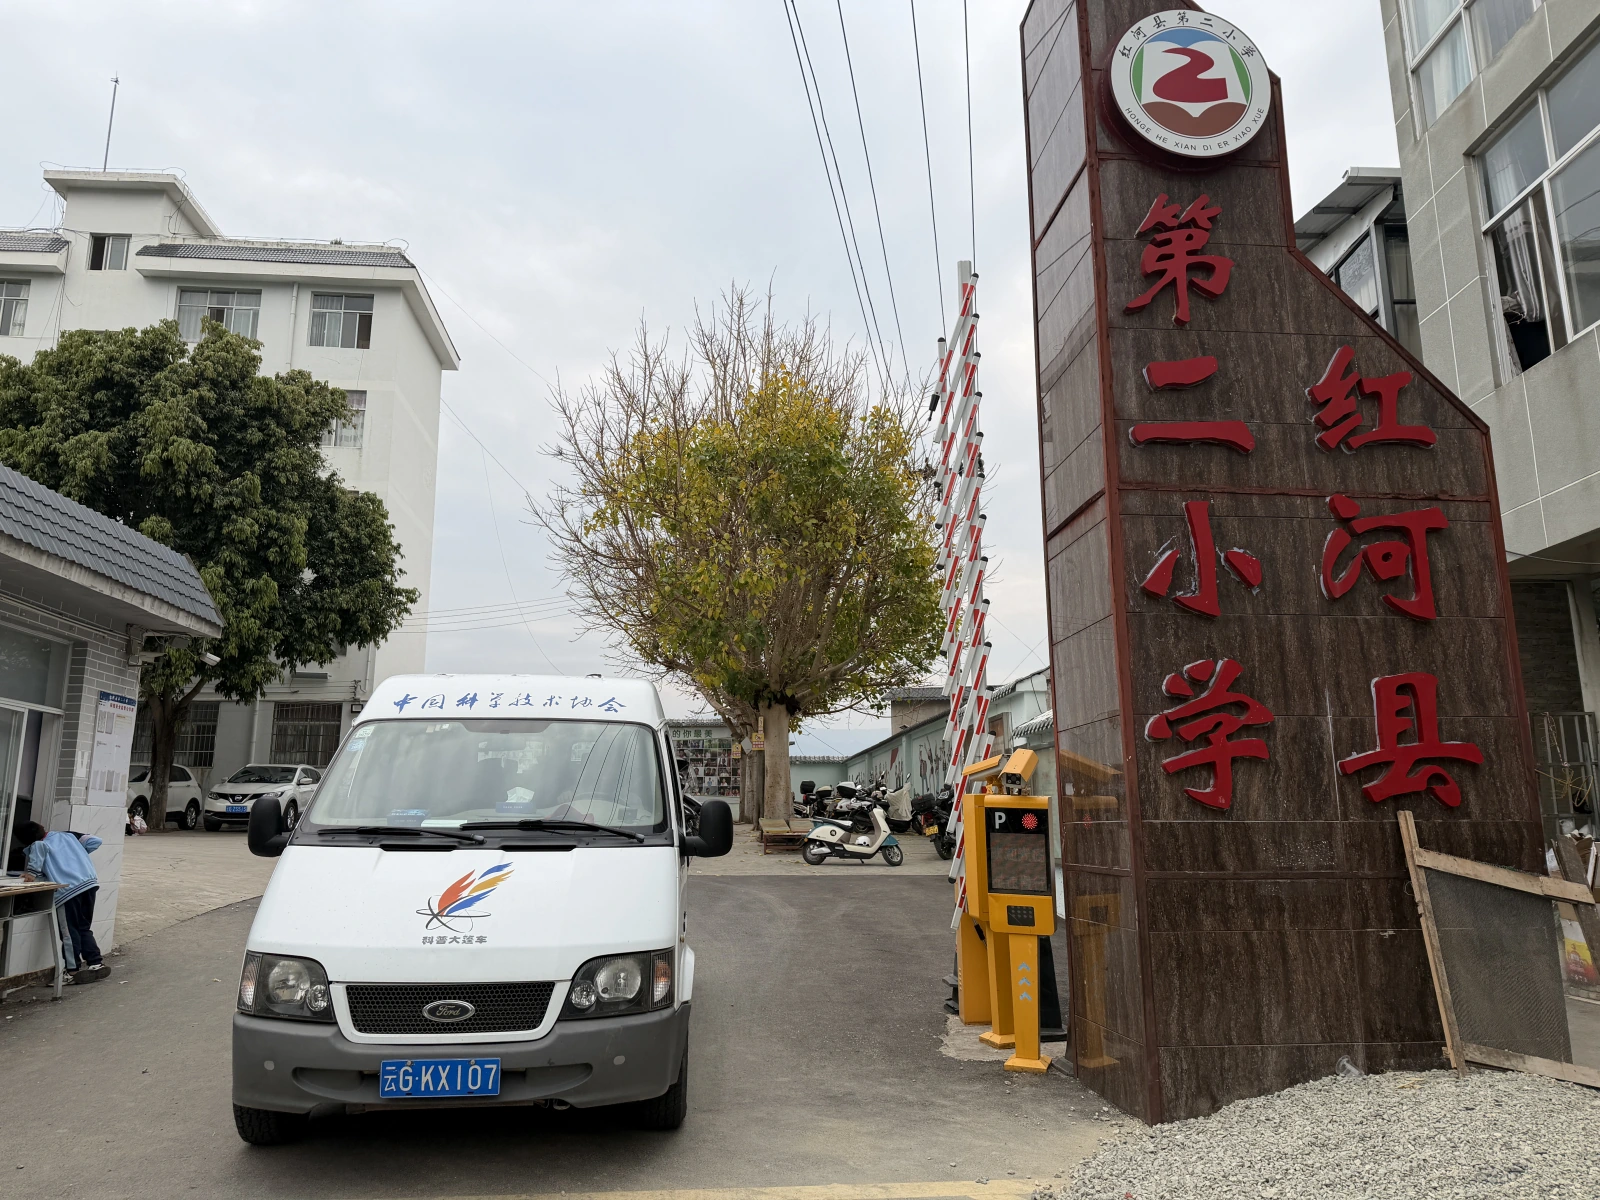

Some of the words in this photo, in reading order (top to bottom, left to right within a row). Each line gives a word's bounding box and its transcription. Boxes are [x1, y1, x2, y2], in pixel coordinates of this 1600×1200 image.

[1119, 11, 1257, 59] 红河县第二小学
[1125, 107, 1152, 134] HONGE
[1155, 134, 1168, 144] HE
[1174, 141, 1197, 151] XIAN
[1217, 140, 1230, 149] ER
[1232, 126, 1252, 143] XIAO
[1252, 107, 1265, 125] XUE
[1123, 193, 1274, 810] 第二小学
[1305, 344, 1484, 807] 红河县
[393, 692, 627, 714] 中国科学技术协会
[672, 729, 713, 738] 的你最美
[994, 811, 1007, 830] P
[435, 1005, 462, 1016] Ford
[384, 1064, 498, 1092] 云G·KX107
